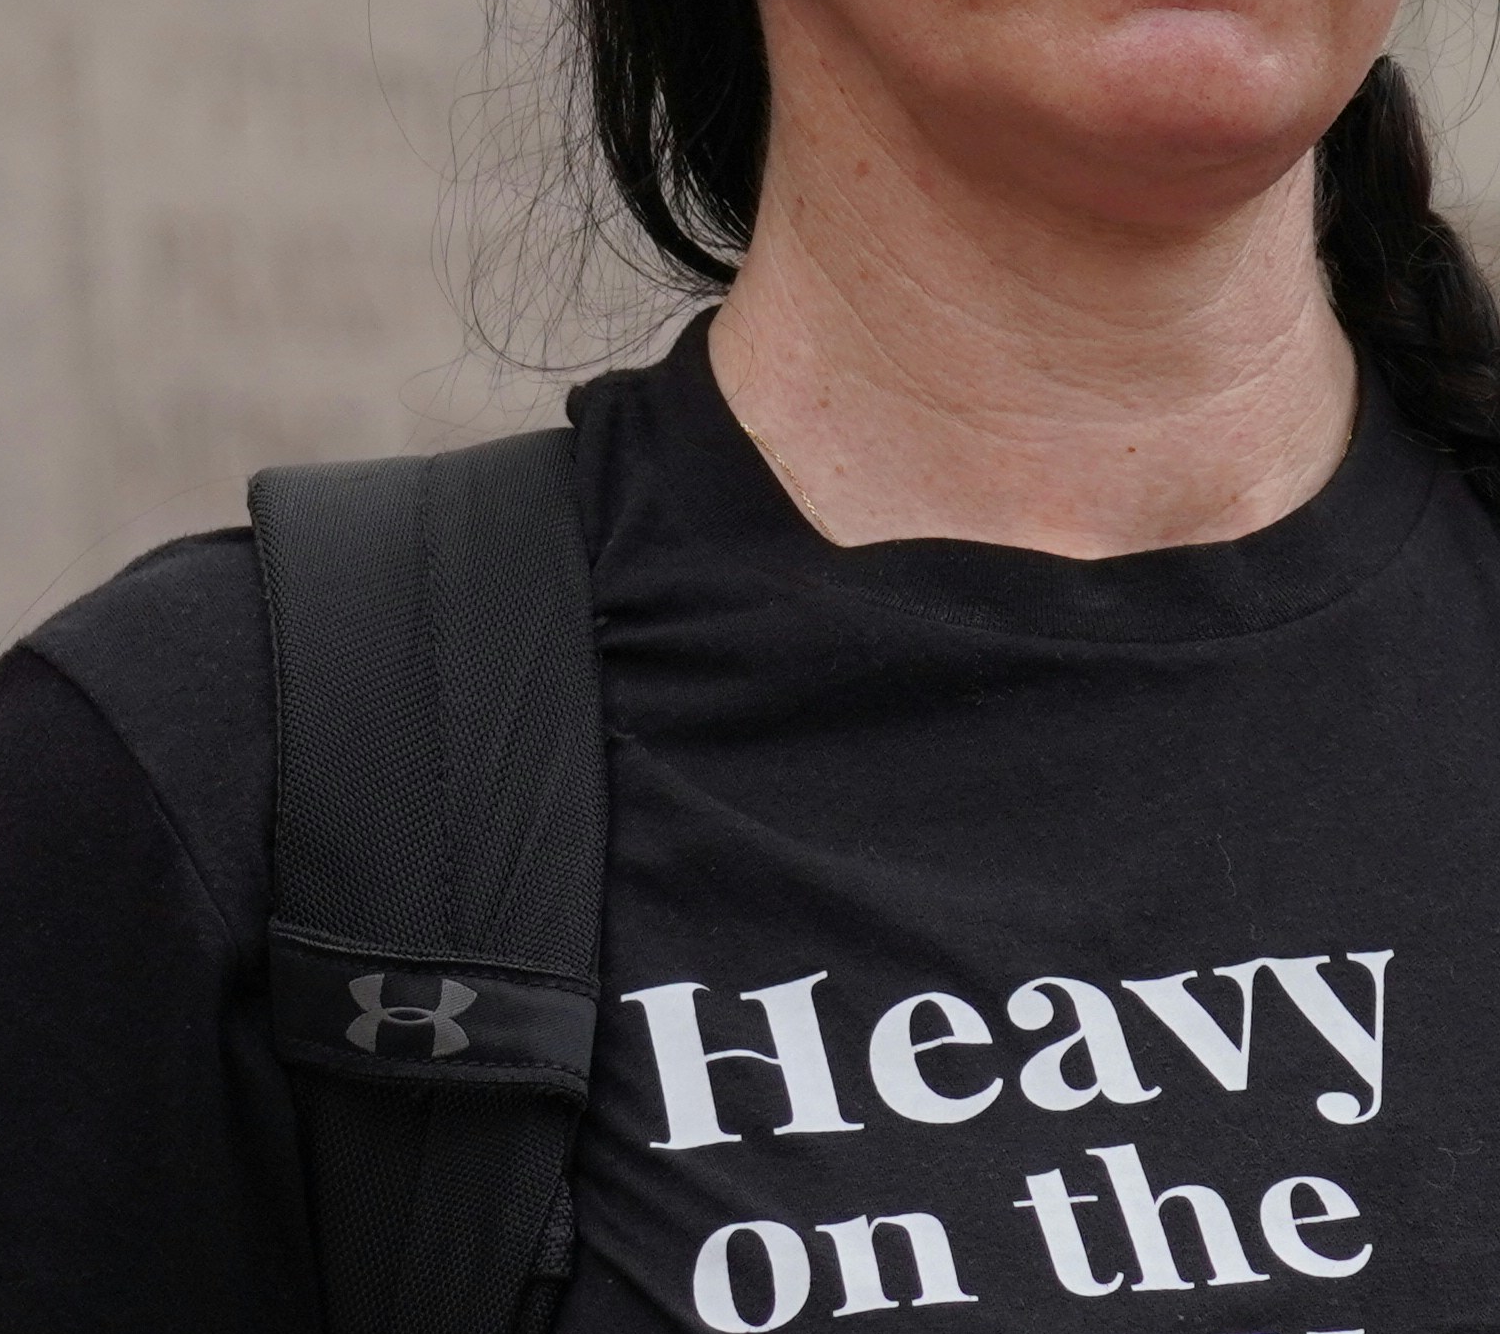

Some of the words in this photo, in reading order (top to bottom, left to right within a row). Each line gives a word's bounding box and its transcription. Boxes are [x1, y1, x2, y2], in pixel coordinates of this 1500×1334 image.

[620, 949, 1395, 1150] Heavy
[692, 1212, 979, 1334] on
[1013, 1143, 1373, 1297] the
